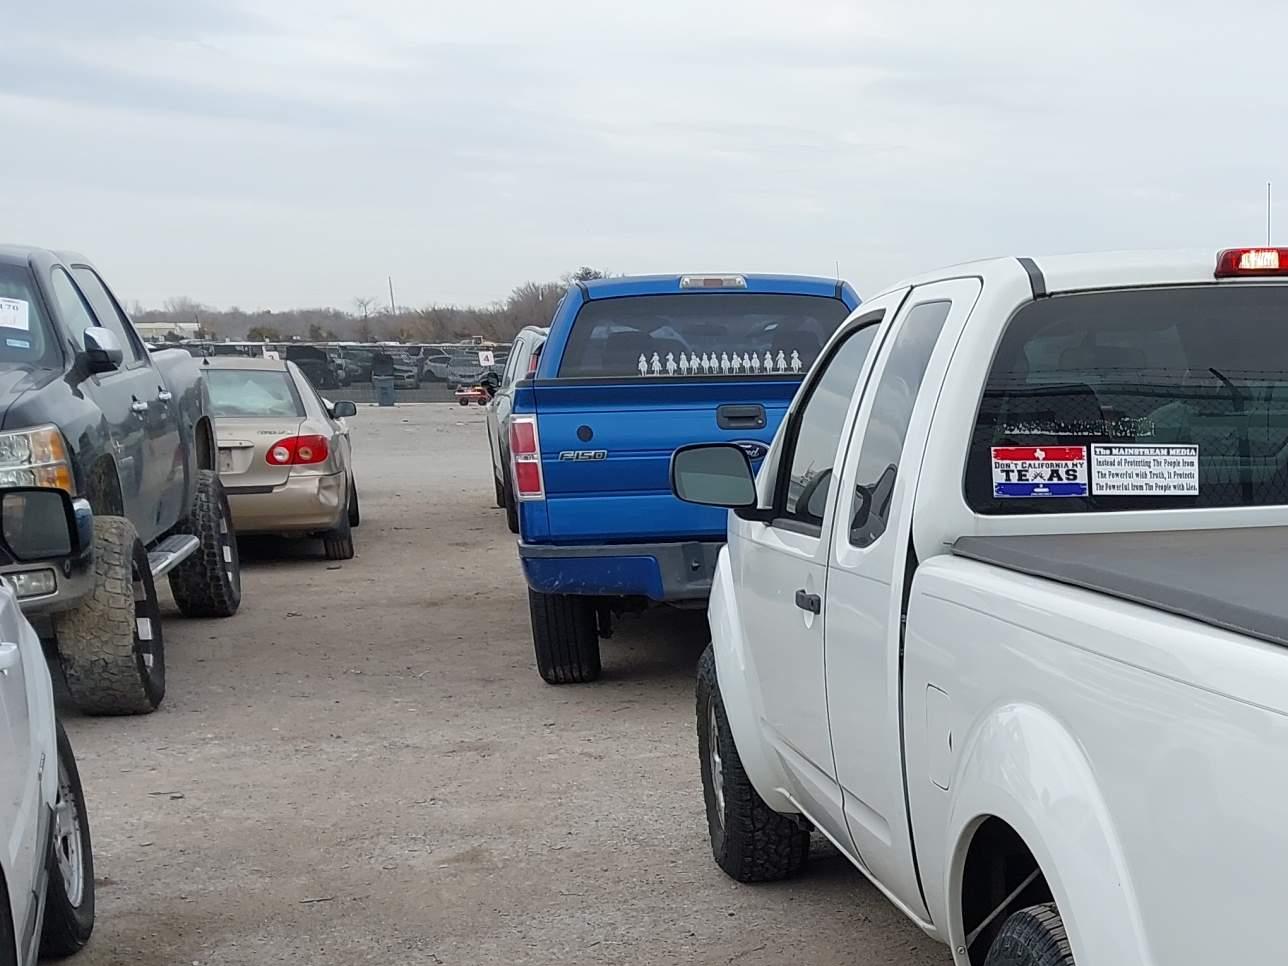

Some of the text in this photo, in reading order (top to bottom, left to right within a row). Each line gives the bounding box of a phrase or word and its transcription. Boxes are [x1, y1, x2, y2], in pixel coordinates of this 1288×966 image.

[1169, 448, 1196, 456] MEDIA
[995, 461, 1084, 469] DON'T CALIFORNIA MY
[1164, 459, 1180, 468] People
[1000, 469, 1078, 482] TEXAS
[1108, 471, 1133, 479] Powerful
